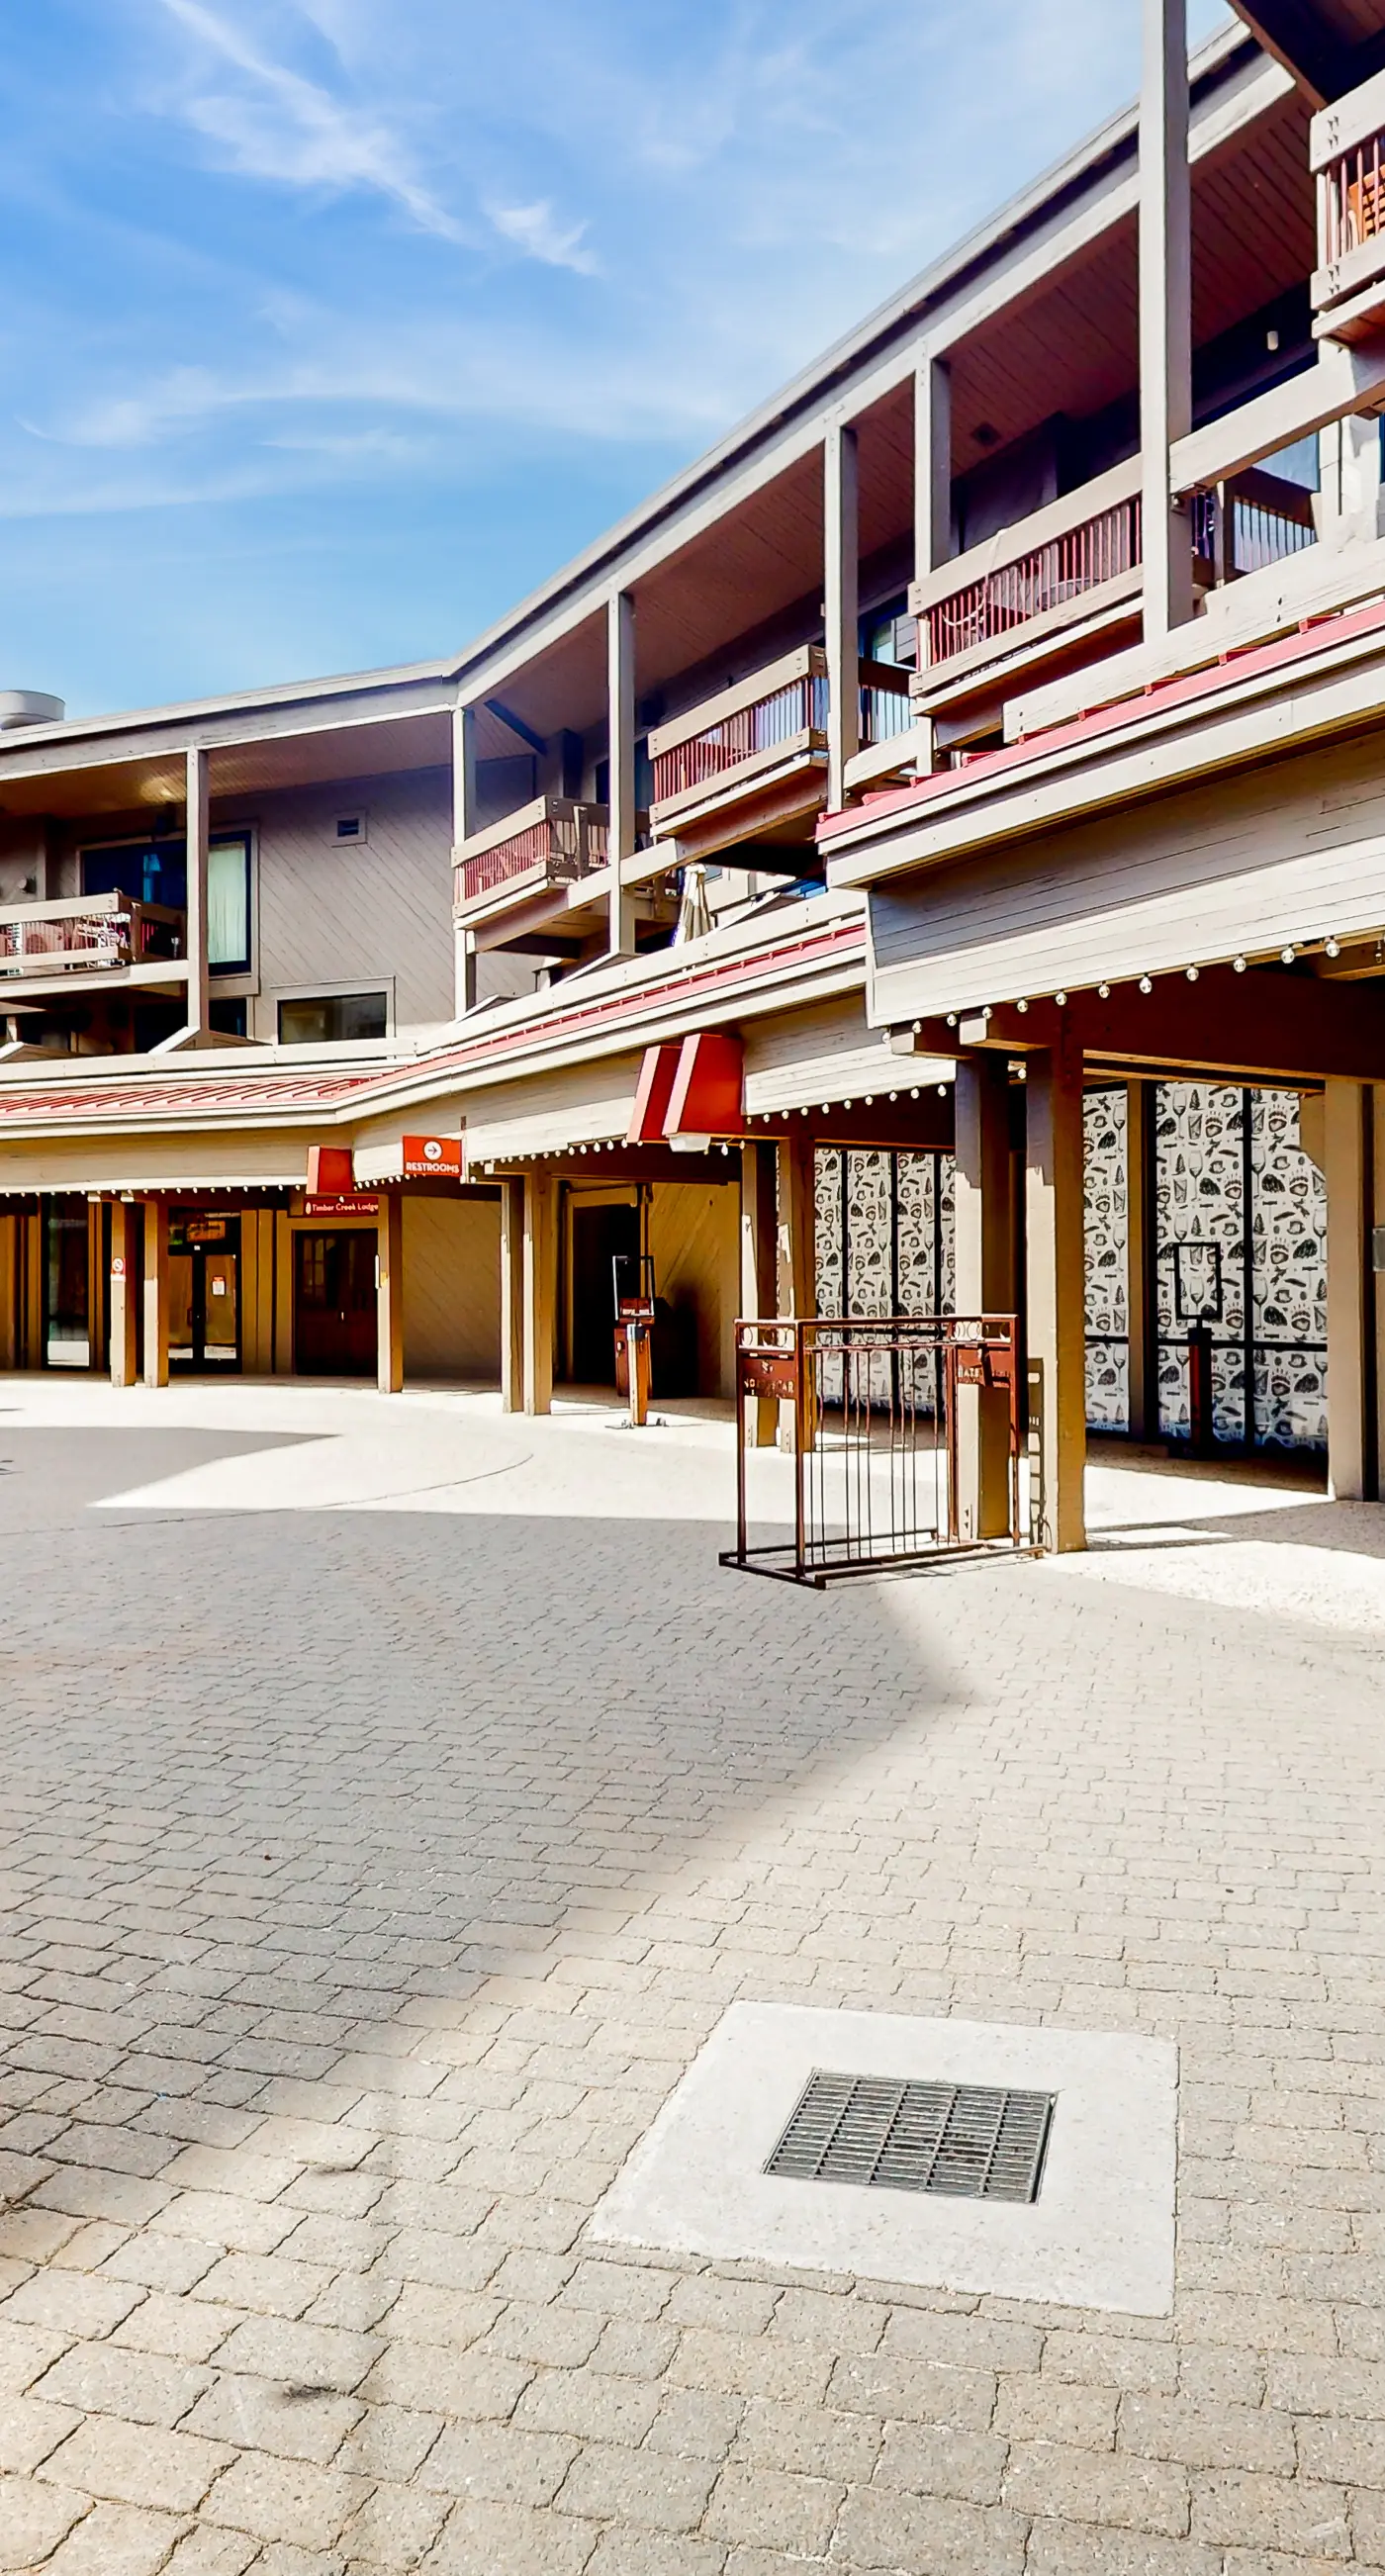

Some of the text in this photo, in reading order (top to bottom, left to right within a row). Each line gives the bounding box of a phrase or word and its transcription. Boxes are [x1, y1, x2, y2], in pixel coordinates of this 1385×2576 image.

[406, 1161, 460, 1173] RESTROOMS
[312, 1202, 379, 1213] Timber Creek Lodge
